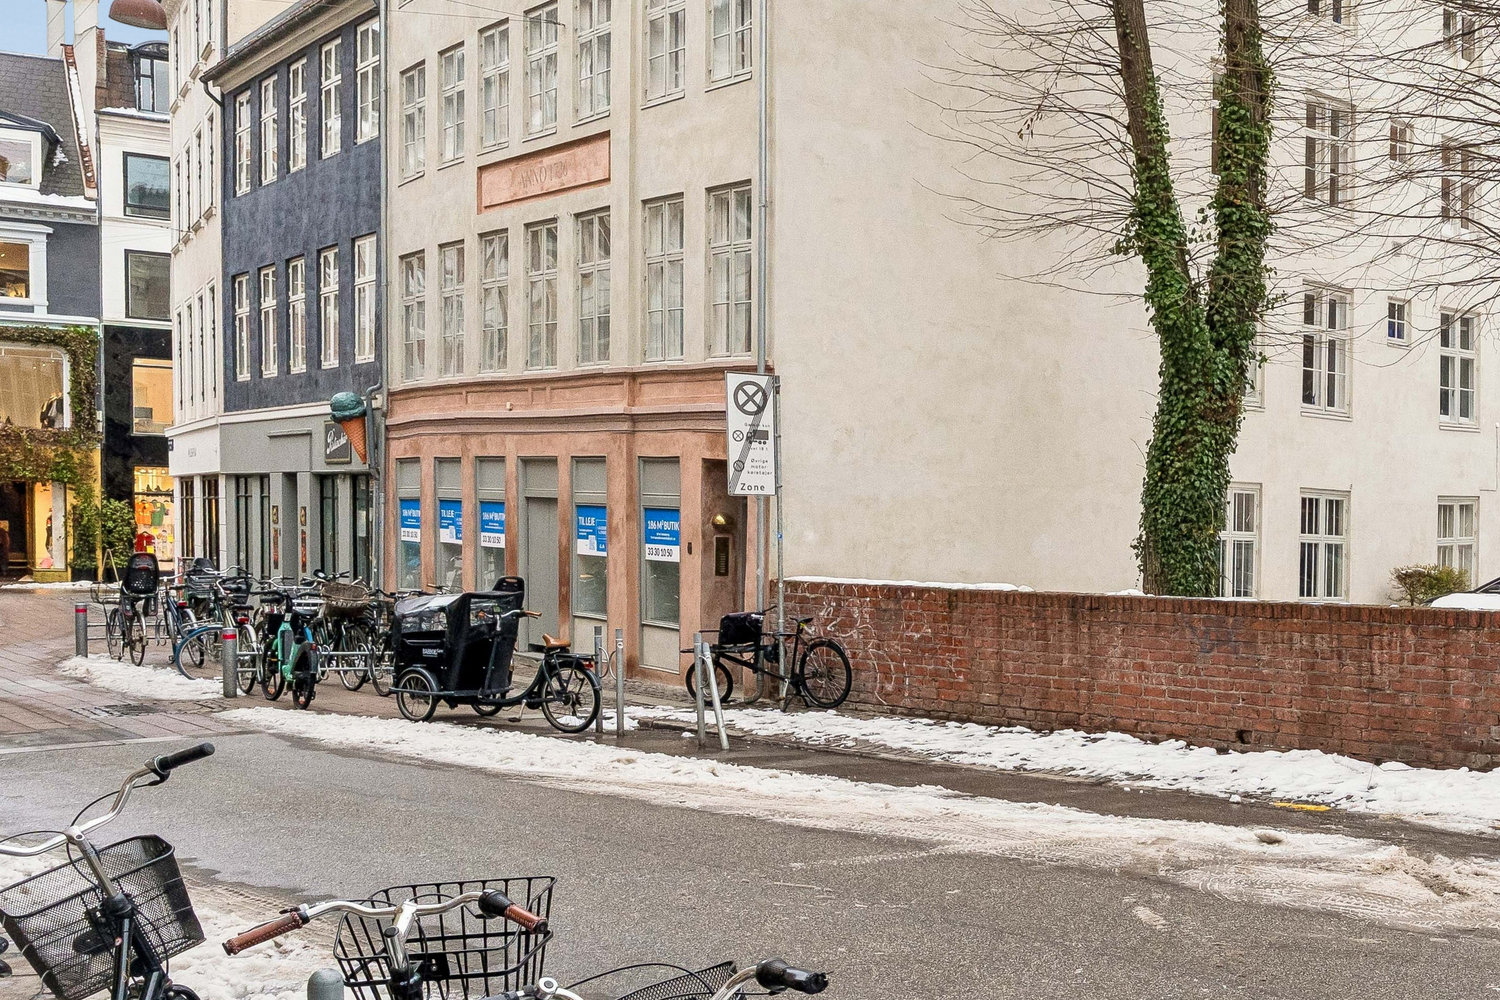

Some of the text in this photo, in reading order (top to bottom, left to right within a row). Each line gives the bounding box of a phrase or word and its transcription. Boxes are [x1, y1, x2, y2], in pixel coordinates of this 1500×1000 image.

[740, 483, 765, 491] Zone
[586, 517, 595, 526] LEJE
[648, 547, 673, 557] 33 30 10 50
